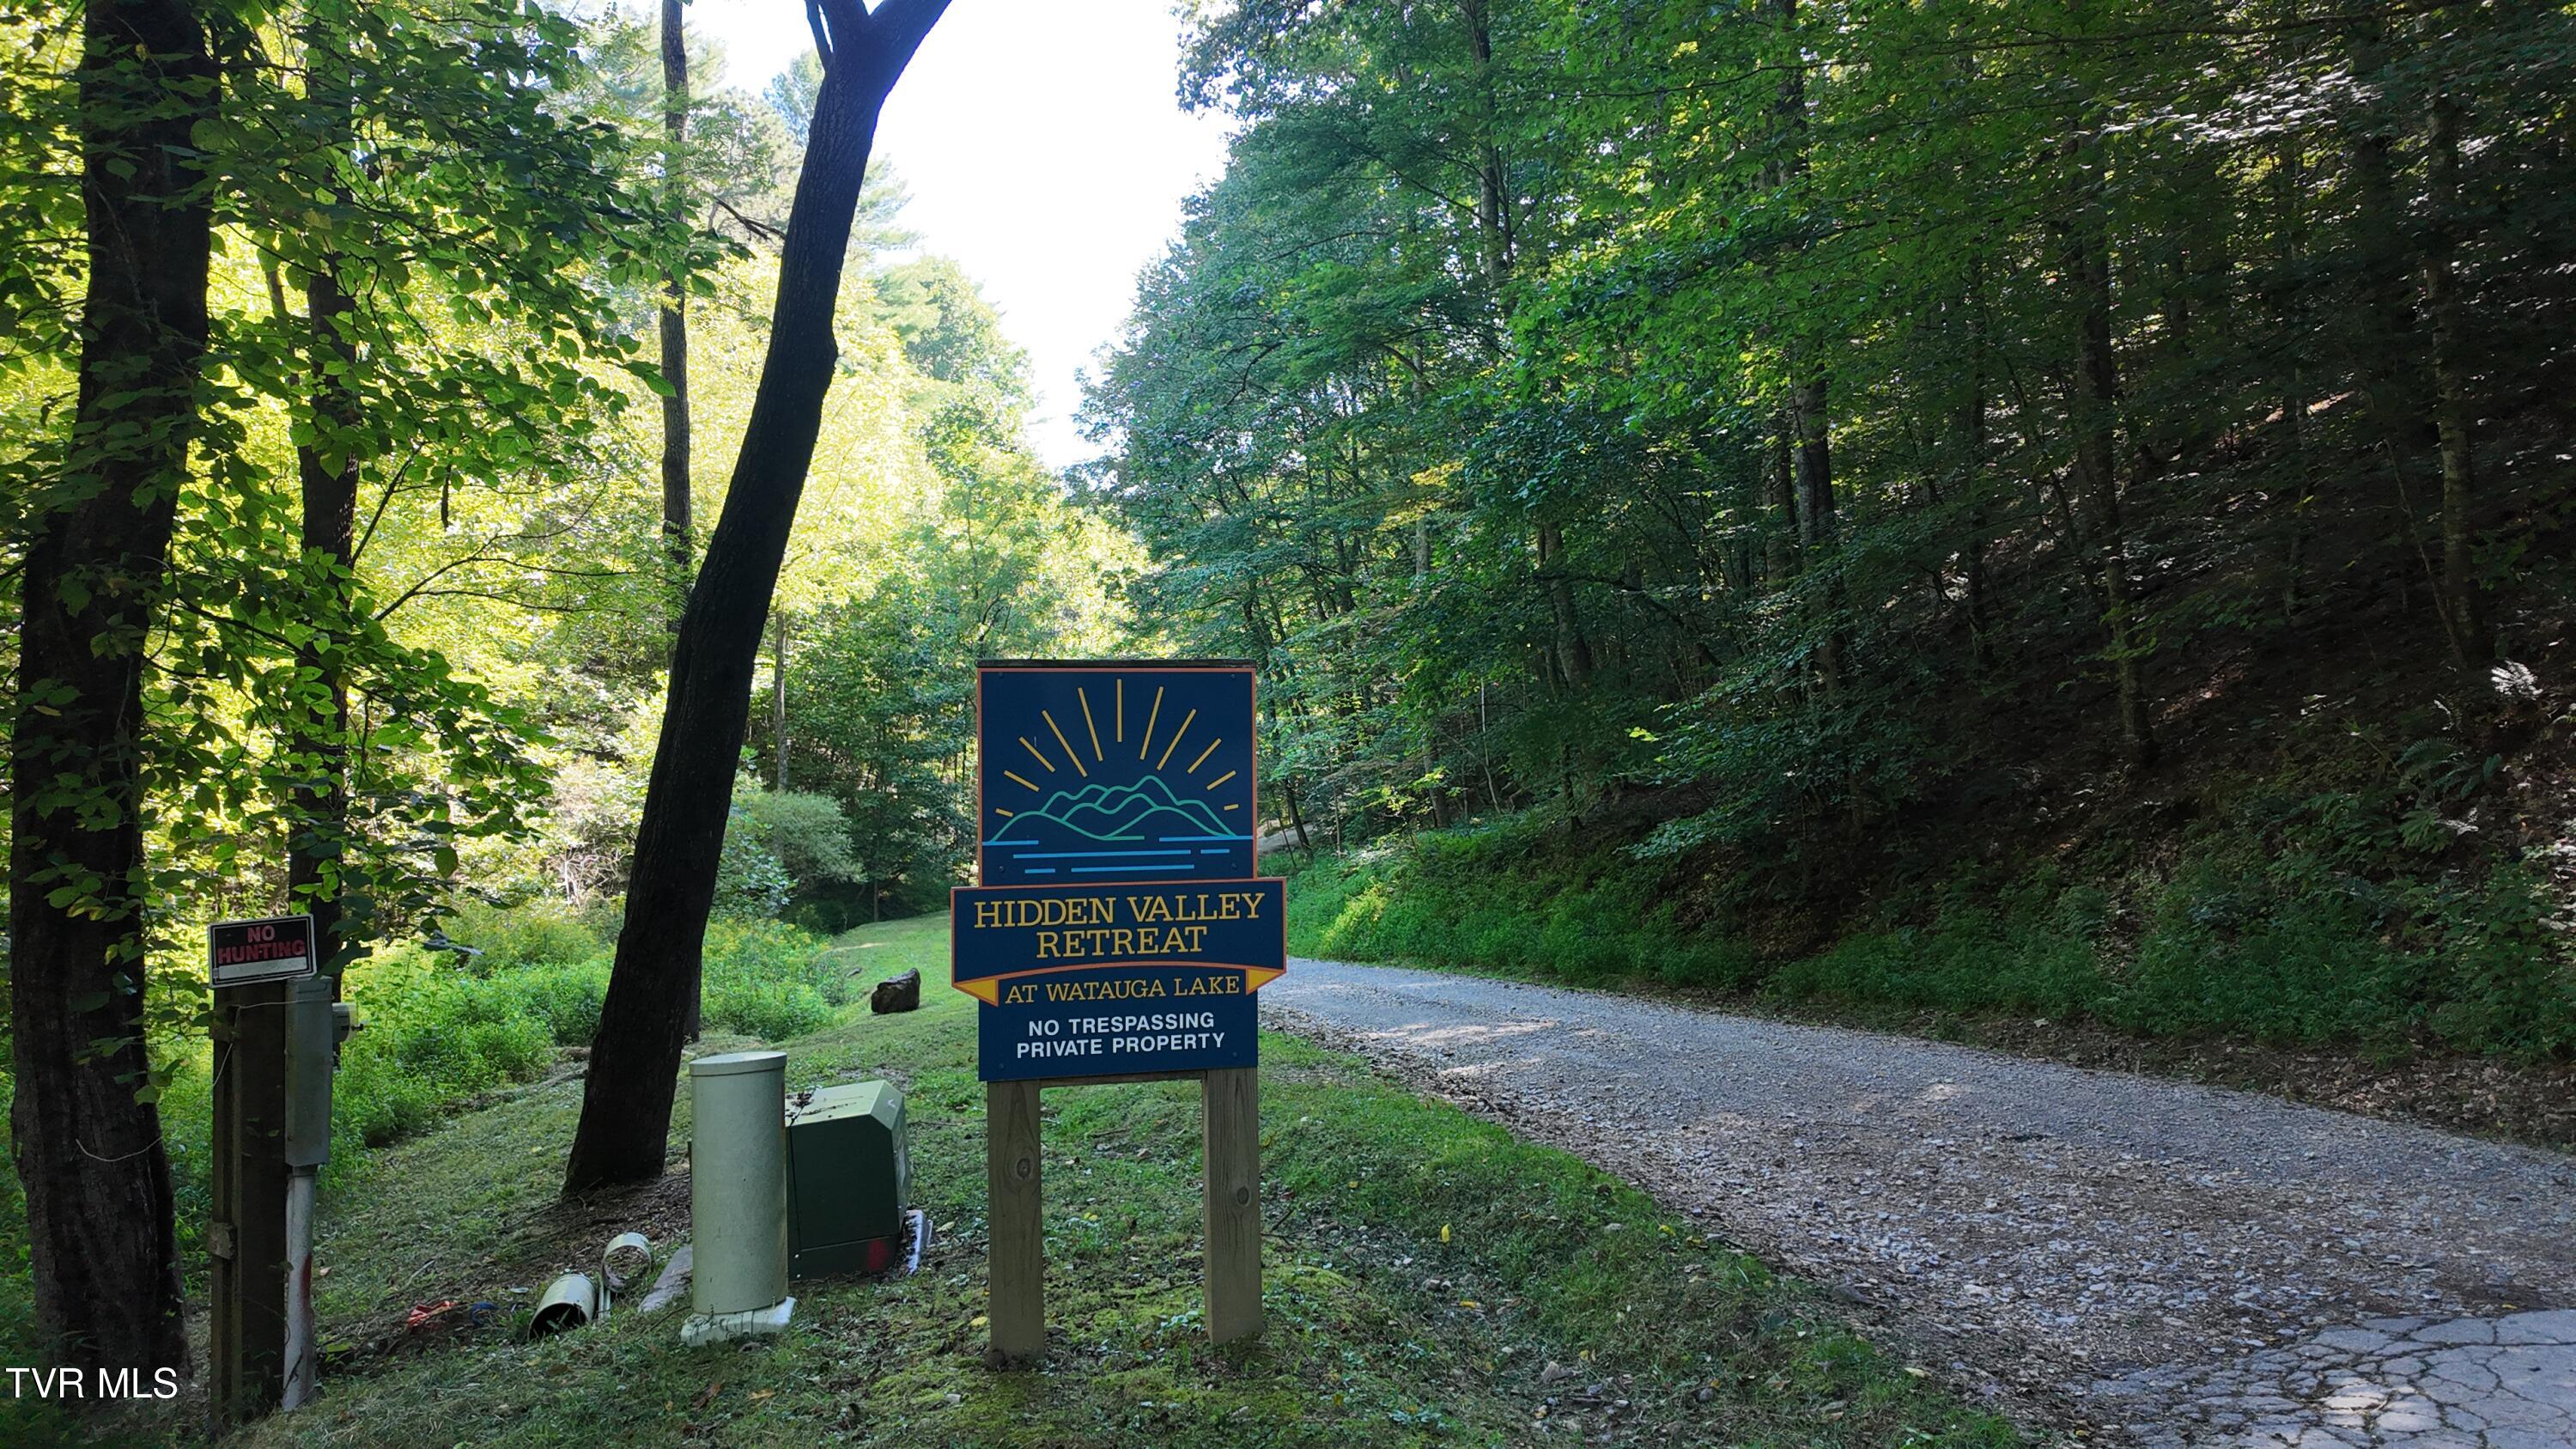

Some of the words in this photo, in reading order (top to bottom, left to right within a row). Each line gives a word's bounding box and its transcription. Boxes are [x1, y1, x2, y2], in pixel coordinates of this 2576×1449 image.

[974, 898, 1116, 928] HIDDEN
[1127, 892, 1265, 922] VALLEY
[247, 925, 275, 943] NO
[1036, 926, 1207, 959] RETREAT
[218, 940, 306, 964] HUNTING
[1005, 984, 1037, 1003] AT
[1046, 979, 1166, 1001] WATAUGA
[1175, 976, 1239, 995] LAKE
[1029, 1020, 1060, 1037] NO
[1068, 1012, 1214, 1034] TRESPASSING
[1017, 1038, 1103, 1058] PRIVATE
[1112, 1032, 1225, 1054] PROPERTY
